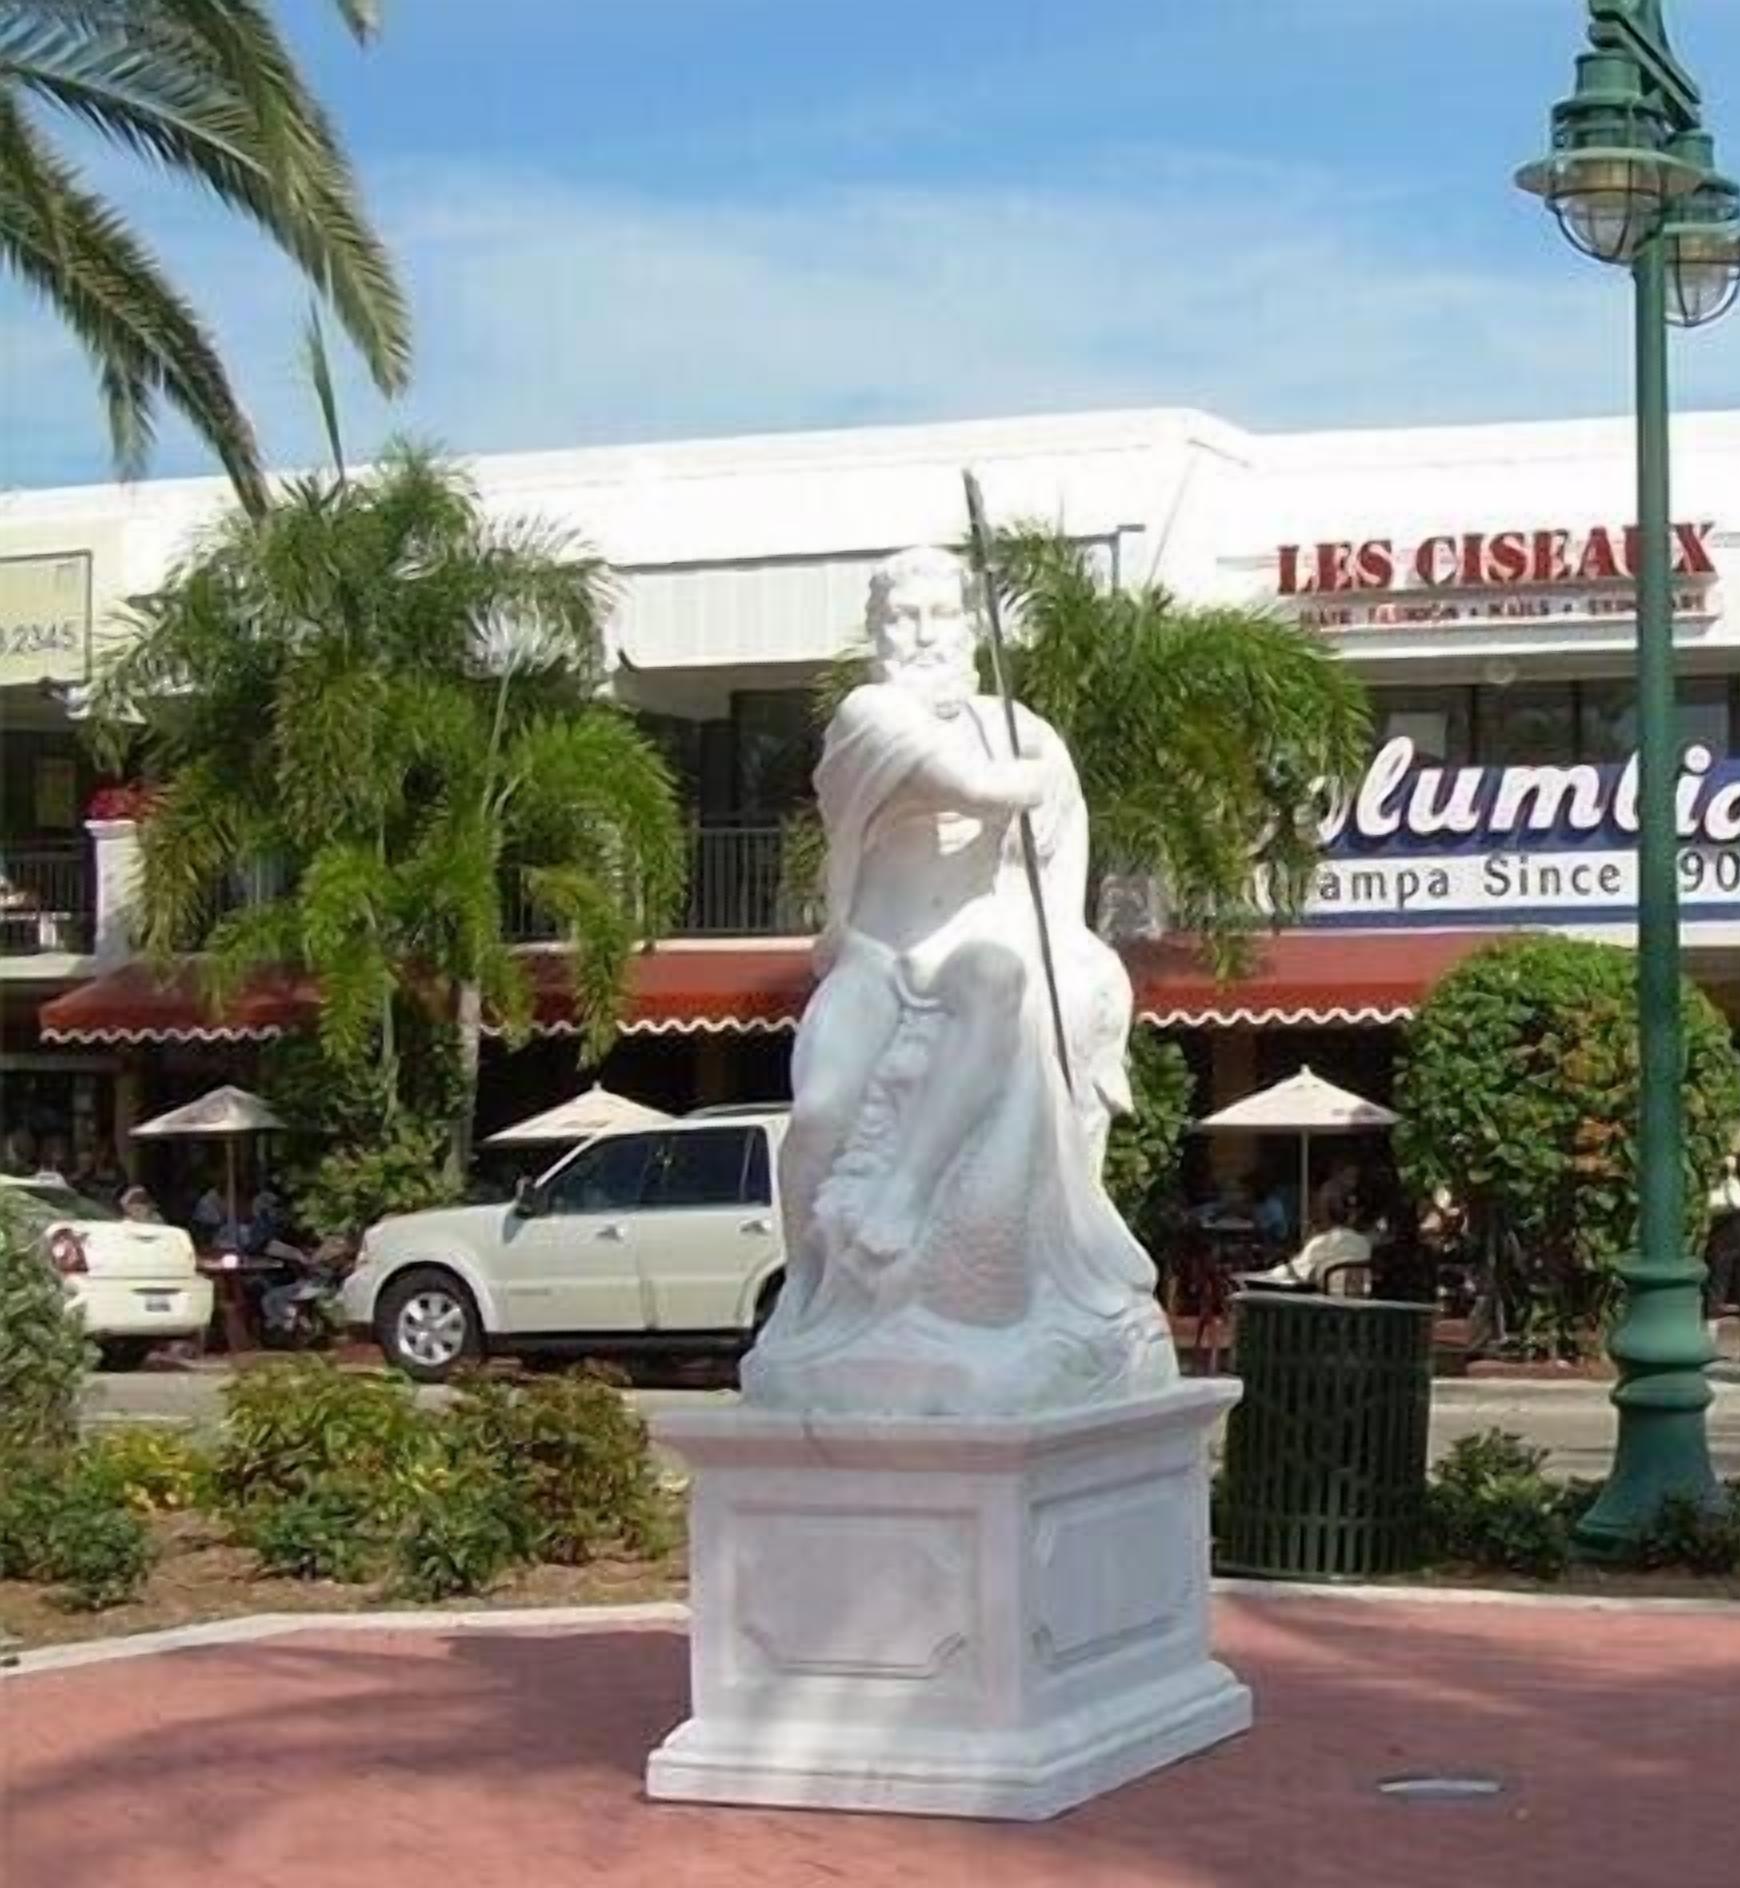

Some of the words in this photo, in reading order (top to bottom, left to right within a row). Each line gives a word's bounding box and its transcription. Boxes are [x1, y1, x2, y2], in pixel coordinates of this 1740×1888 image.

[1277, 540, 1394, 594] LES
[1319, 868, 1450, 906] ampa
[1483, 857, 1622, 896] Since
